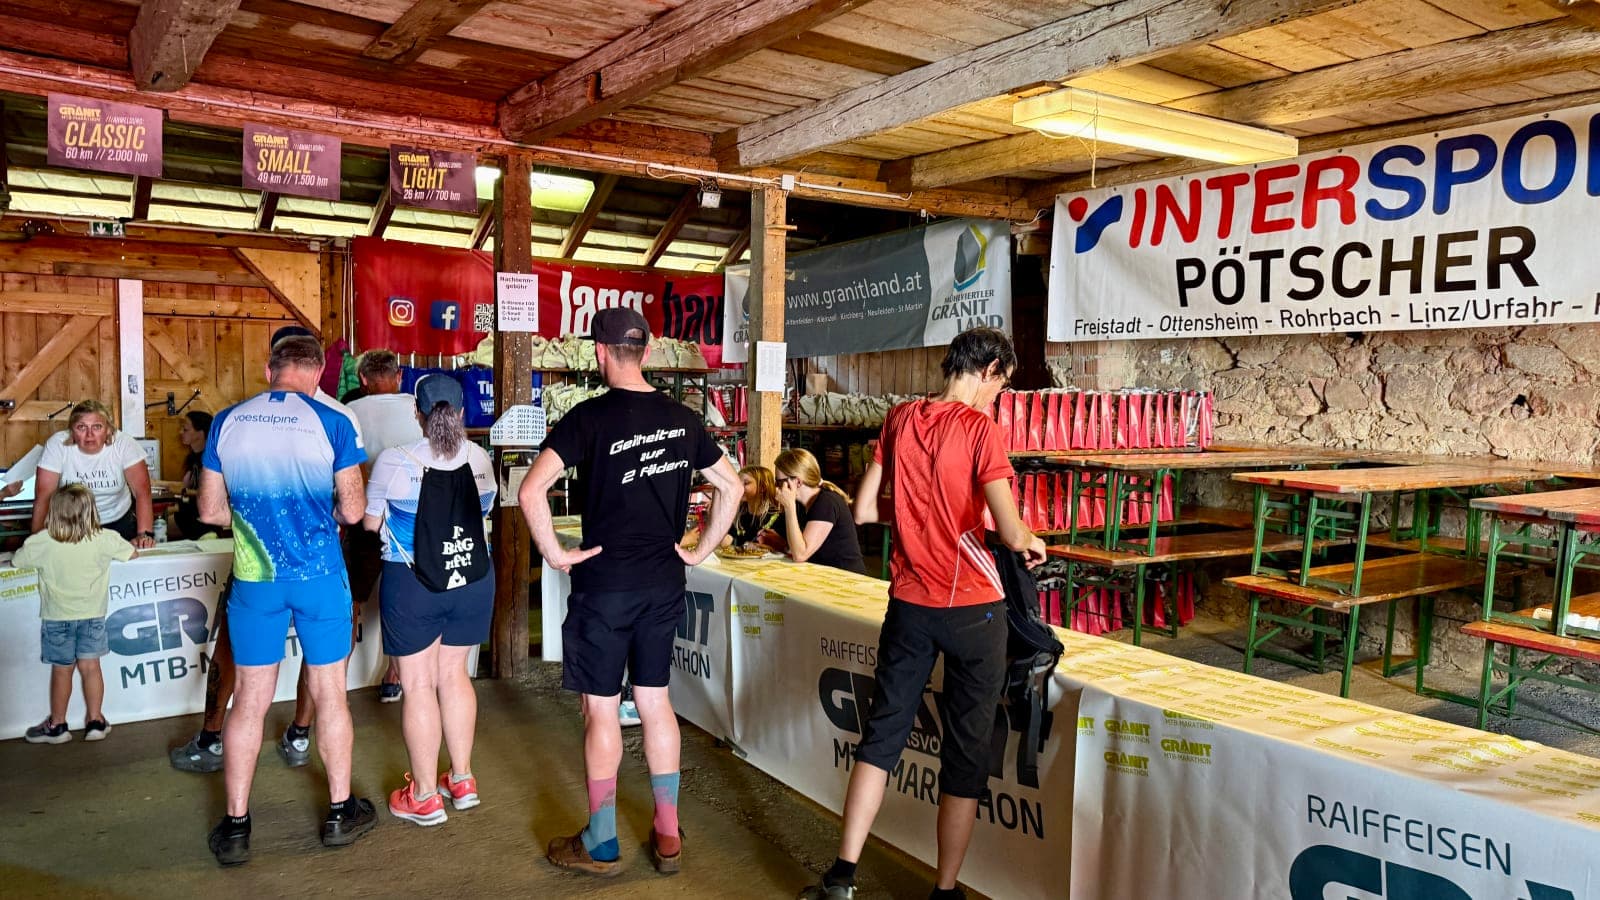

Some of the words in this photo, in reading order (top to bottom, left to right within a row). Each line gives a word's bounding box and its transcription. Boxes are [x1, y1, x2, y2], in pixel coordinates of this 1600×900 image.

[65, 121, 146, 150] CLASSIC
[65, 147, 77, 159] 60
[80, 148, 93, 160] km
[107, 149, 132, 162] 2.000
[135, 150, 148, 162] hm
[257, 148, 311, 174] SMALL
[257, 172, 269, 183] 49
[270, 173, 282, 184] km
[294, 174, 315, 186] 1.500
[317, 175, 329, 187] hm
[402, 166, 447, 189] LIGHT
[1128, 112, 1600, 249] INTERSPO
[403, 189, 414, 200] 26
[414, 189, 425, 200] km
[436, 190, 449, 201] 700
[450, 191, 461, 201] hm
[1175, 224, 1539, 308] PÖTSCHER
[786, 271, 923, 309] www.granitland.at
[932, 298, 989, 321] GRANIT
[1074, 316, 1142, 335] Freistadt
[1159, 312, 1258, 333] Ottensheim
[1280, 305, 1381, 328] Rohrbach
[1409, 295, 1563, 325] Linz/Urfahr
[957, 314, 1004, 333] LAND
[234, 414, 298, 425] voestalpine
[621, 469, 636, 485] 2
[109, 570, 217, 601] RAIFFEISEN
[820, 637, 878, 666] RAIFFEIS
[1104, 719, 1150, 736] GRANIT
[1160, 738, 1212, 757] GRANIT
[1104, 751, 1149, 769] GRANIT
[1307, 794, 1511, 876] RAIFFEISEN
